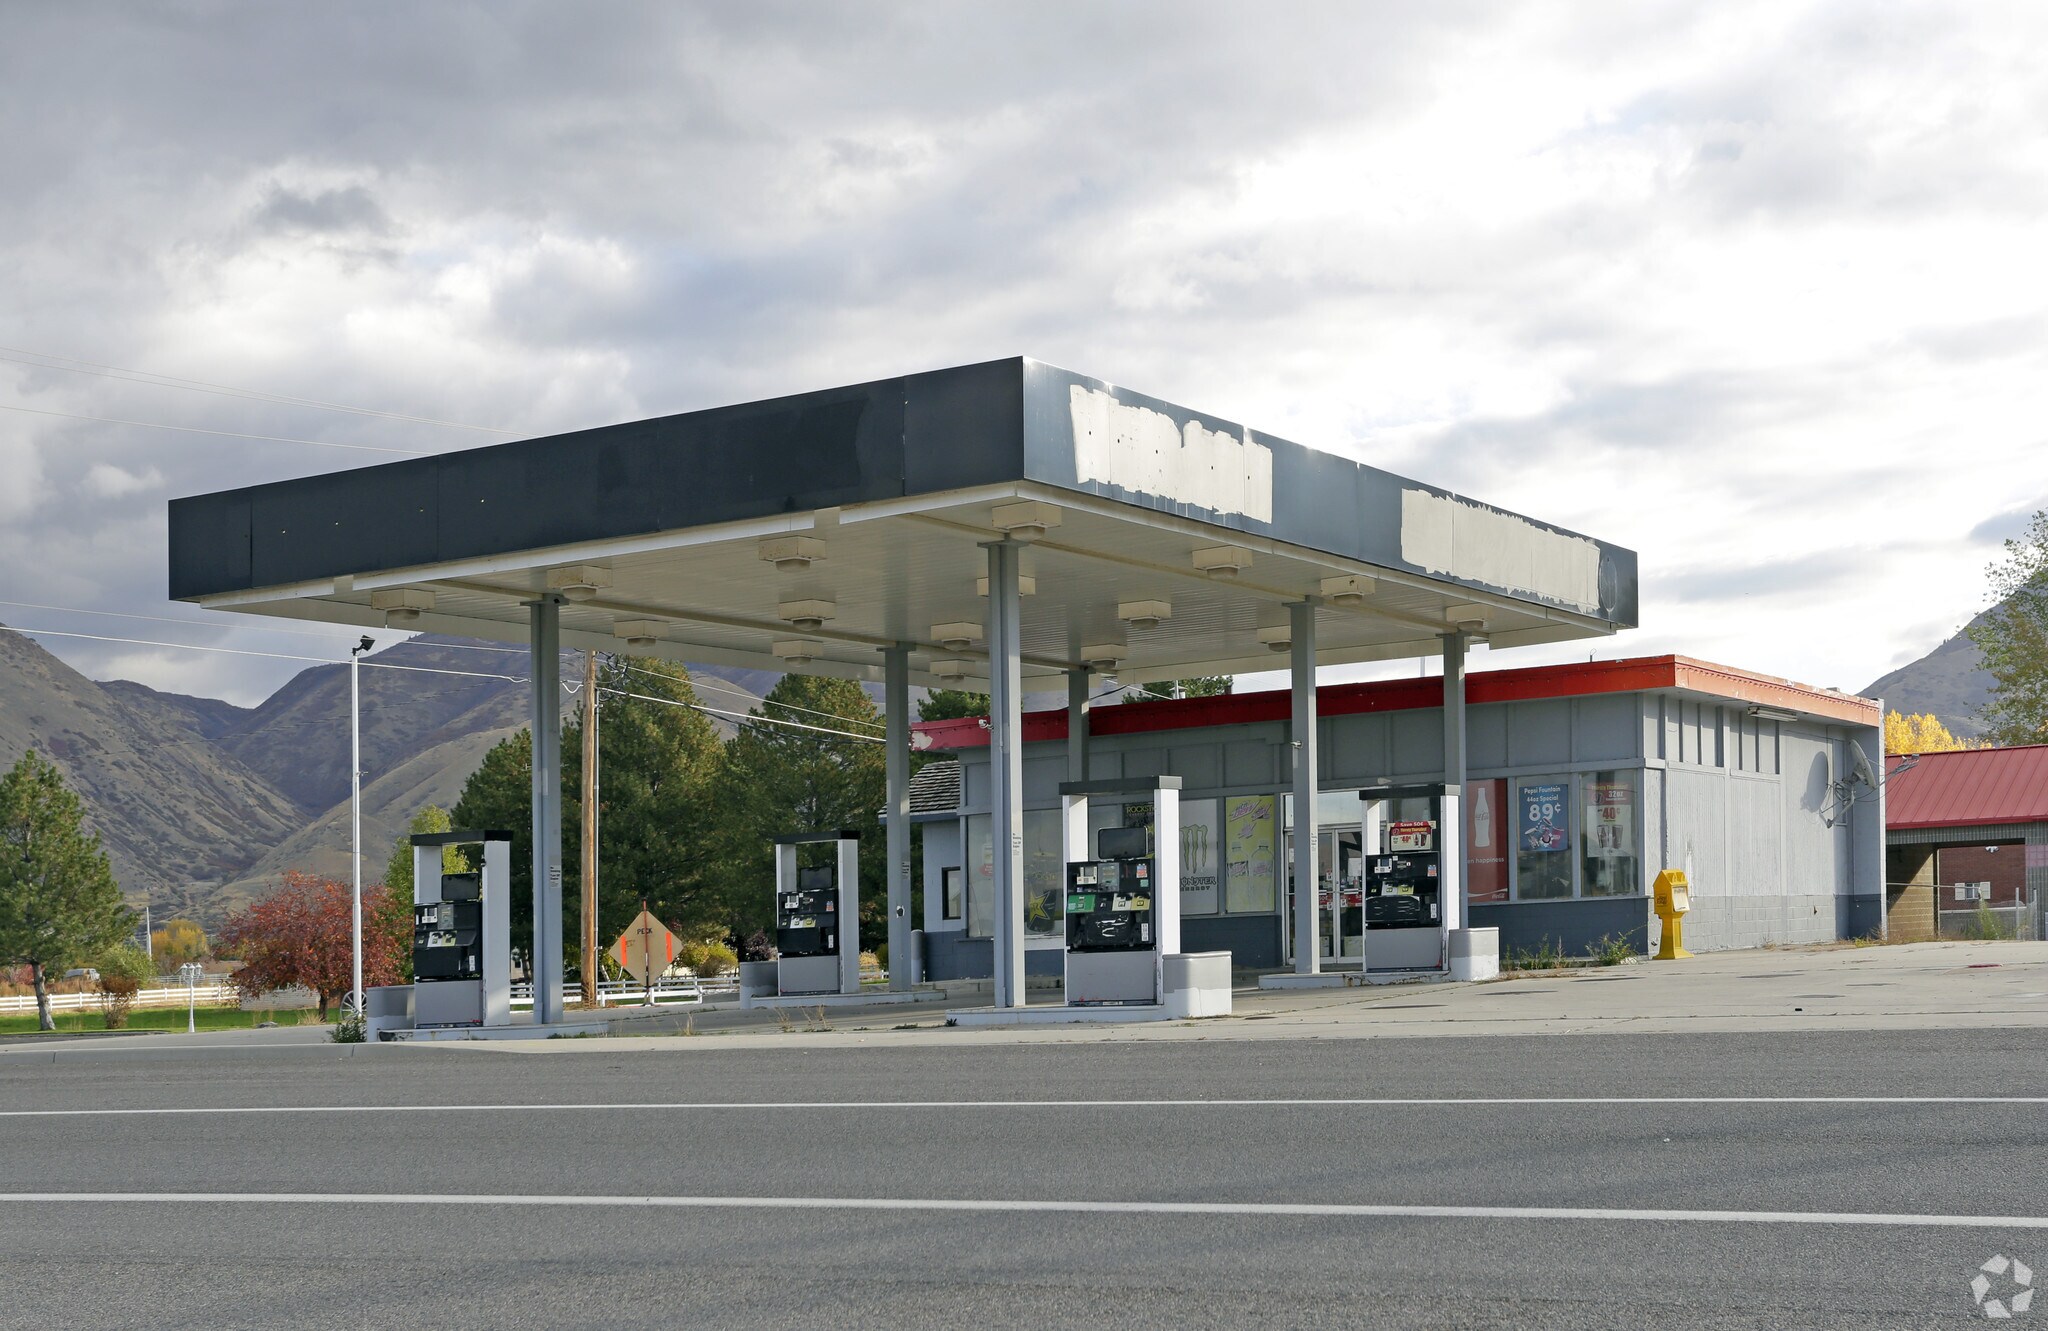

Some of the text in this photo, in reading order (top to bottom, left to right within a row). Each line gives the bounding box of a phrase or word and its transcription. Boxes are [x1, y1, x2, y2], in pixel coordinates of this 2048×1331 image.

[1540, 794, 1559, 802] Special
[1608, 790, 1623, 798] 32oz
[1180, 876, 1217, 887] ONSTER
